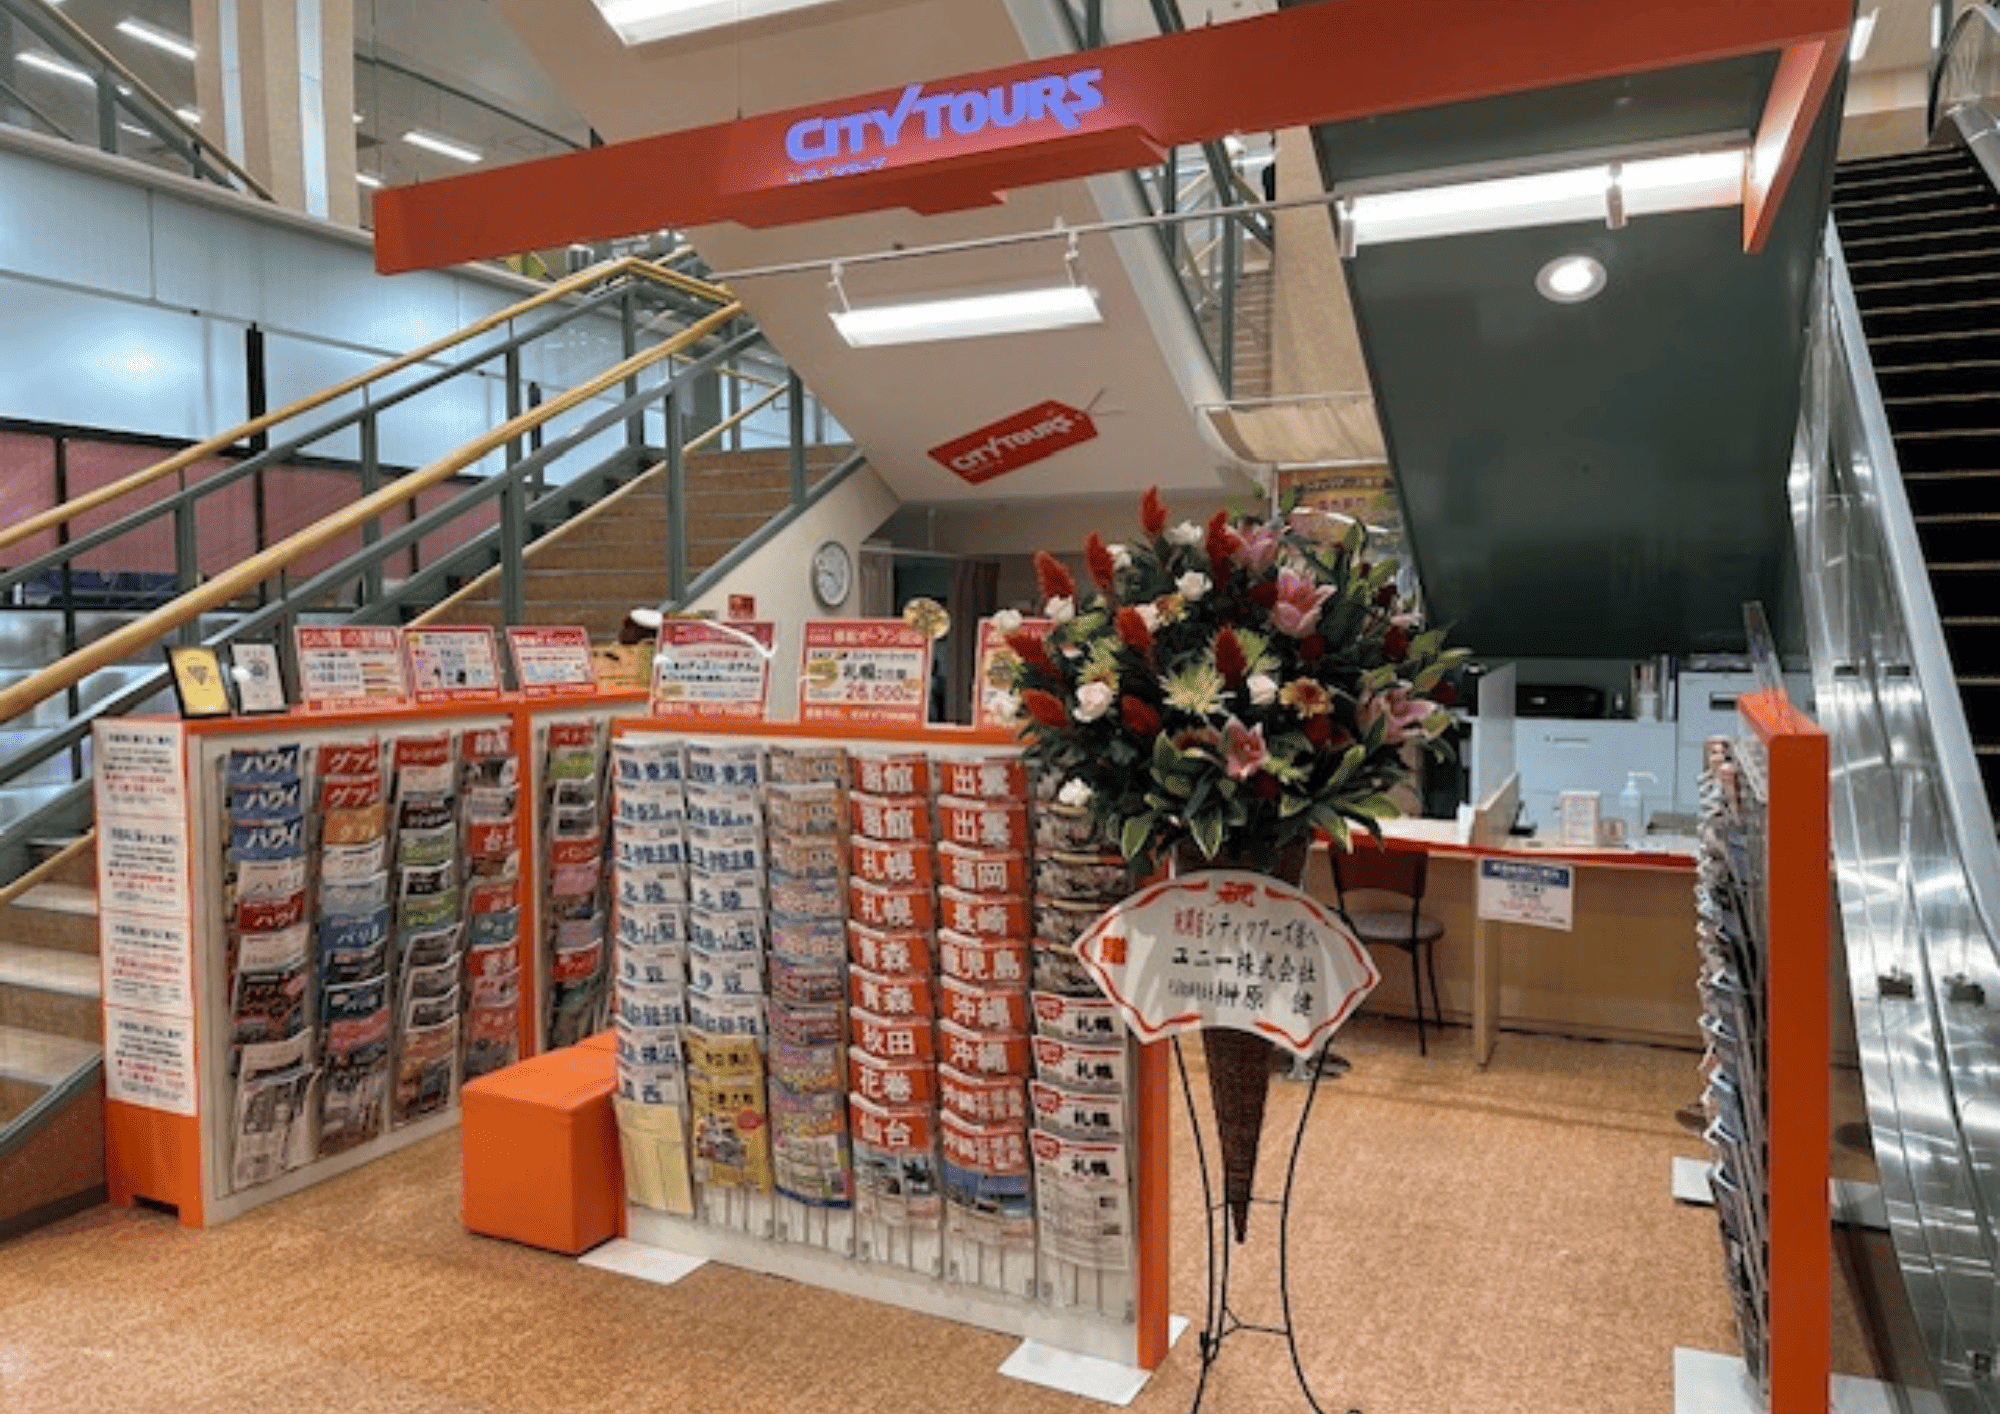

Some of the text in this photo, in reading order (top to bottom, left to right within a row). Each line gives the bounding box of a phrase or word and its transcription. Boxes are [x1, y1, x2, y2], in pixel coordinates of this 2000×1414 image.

[240, 750, 294, 773] ハワイ
[242, 780, 297, 811] ハワイ
[245, 822, 299, 849] ハワイ
[861, 851, 916, 880] 札幌
[953, 857, 1008, 891] 福岡
[861, 893, 914, 927] 札幌
[860, 936, 912, 972] 青森
[941, 943, 1021, 980] 鹿児島
[1171, 946, 1317, 985] ユニー株式会社
[862, 979, 913, 1014] 青森
[952, 995, 1010, 1028] 沖縄
[861, 1019, 915, 1056] 秋田
[1076, 1012, 1114, 1033] 札幌
[952, 1037, 1009, 1073] 沖縄
[1076, 1060, 1114, 1081] 札幌
[860, 1065, 912, 1102] 花巻
[860, 1112, 912, 1147] 仙台
[1073, 1107, 1111, 1128] 札幌
[1071, 1157, 1111, 1178] 札幌
